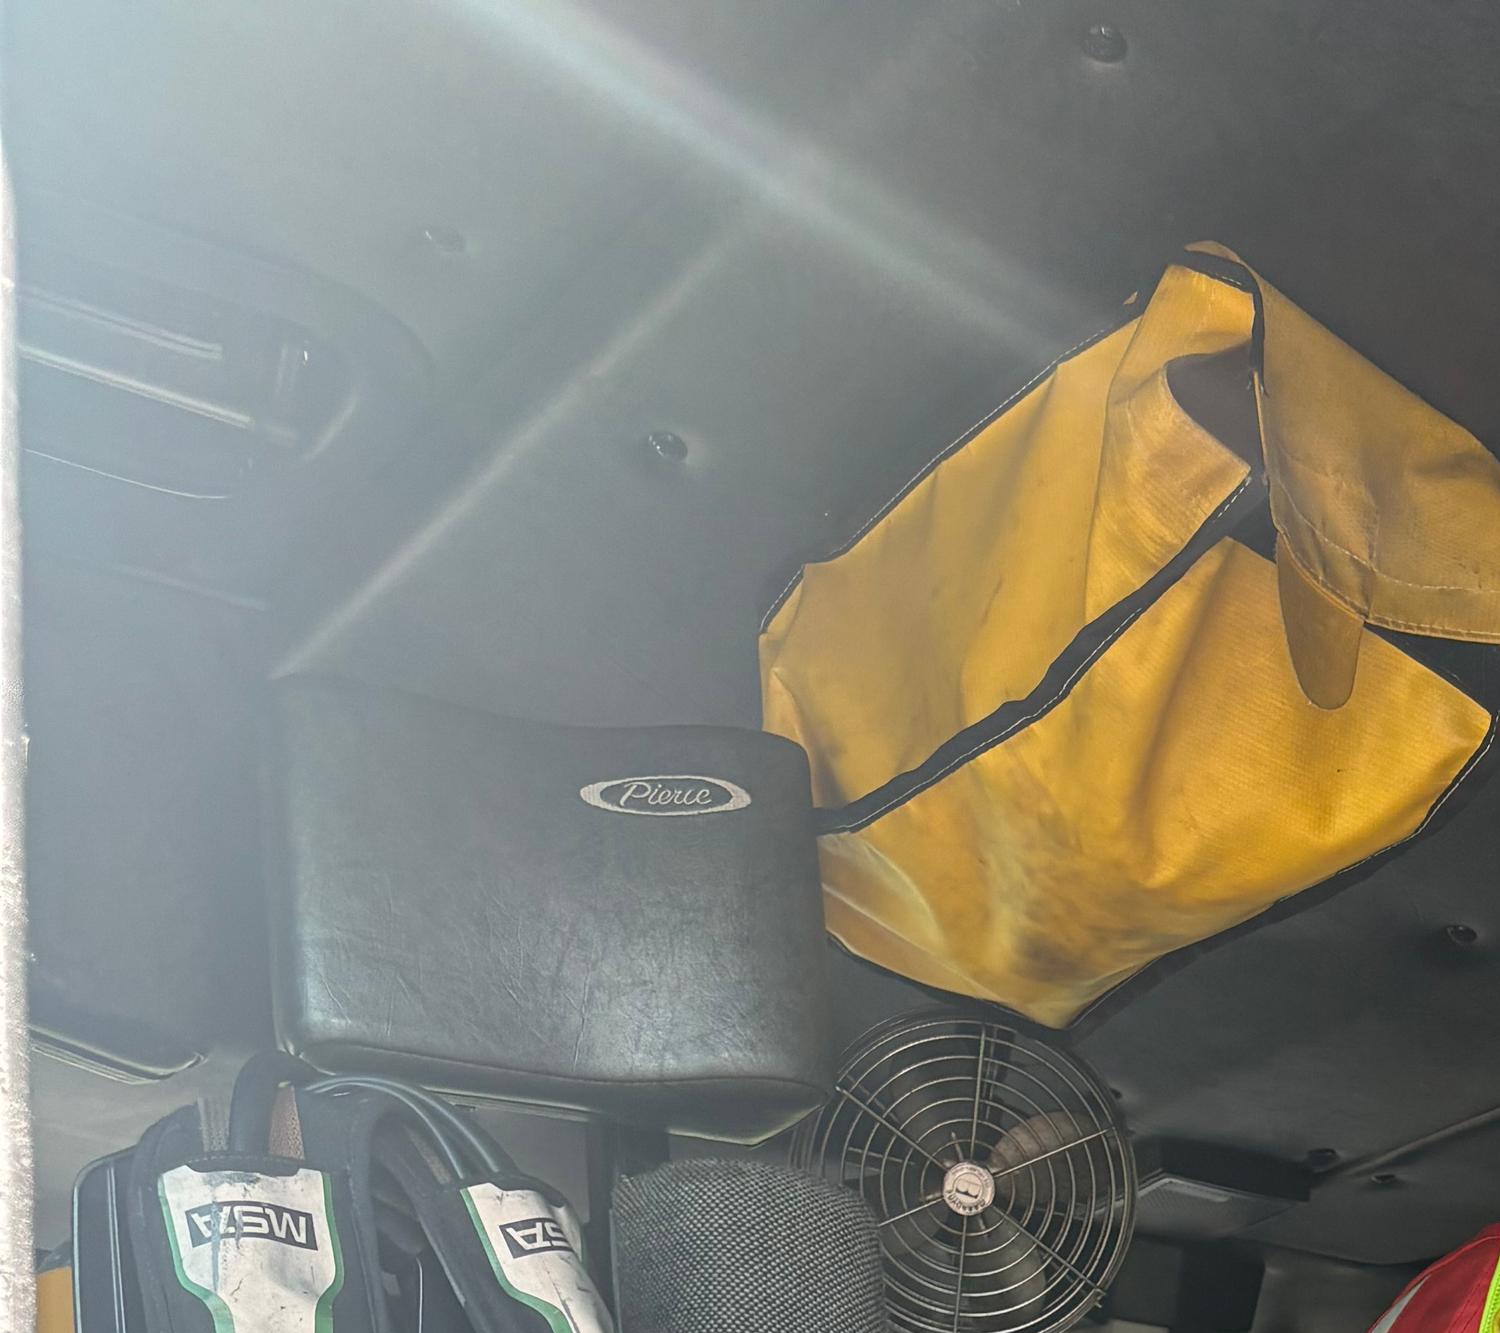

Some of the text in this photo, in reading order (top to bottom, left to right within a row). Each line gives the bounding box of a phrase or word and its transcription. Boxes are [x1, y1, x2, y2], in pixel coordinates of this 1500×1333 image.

[619, 781, 713, 807] Pierce
[191, 1205, 307, 1243] MSA
[505, 1221, 571, 1251] SA
